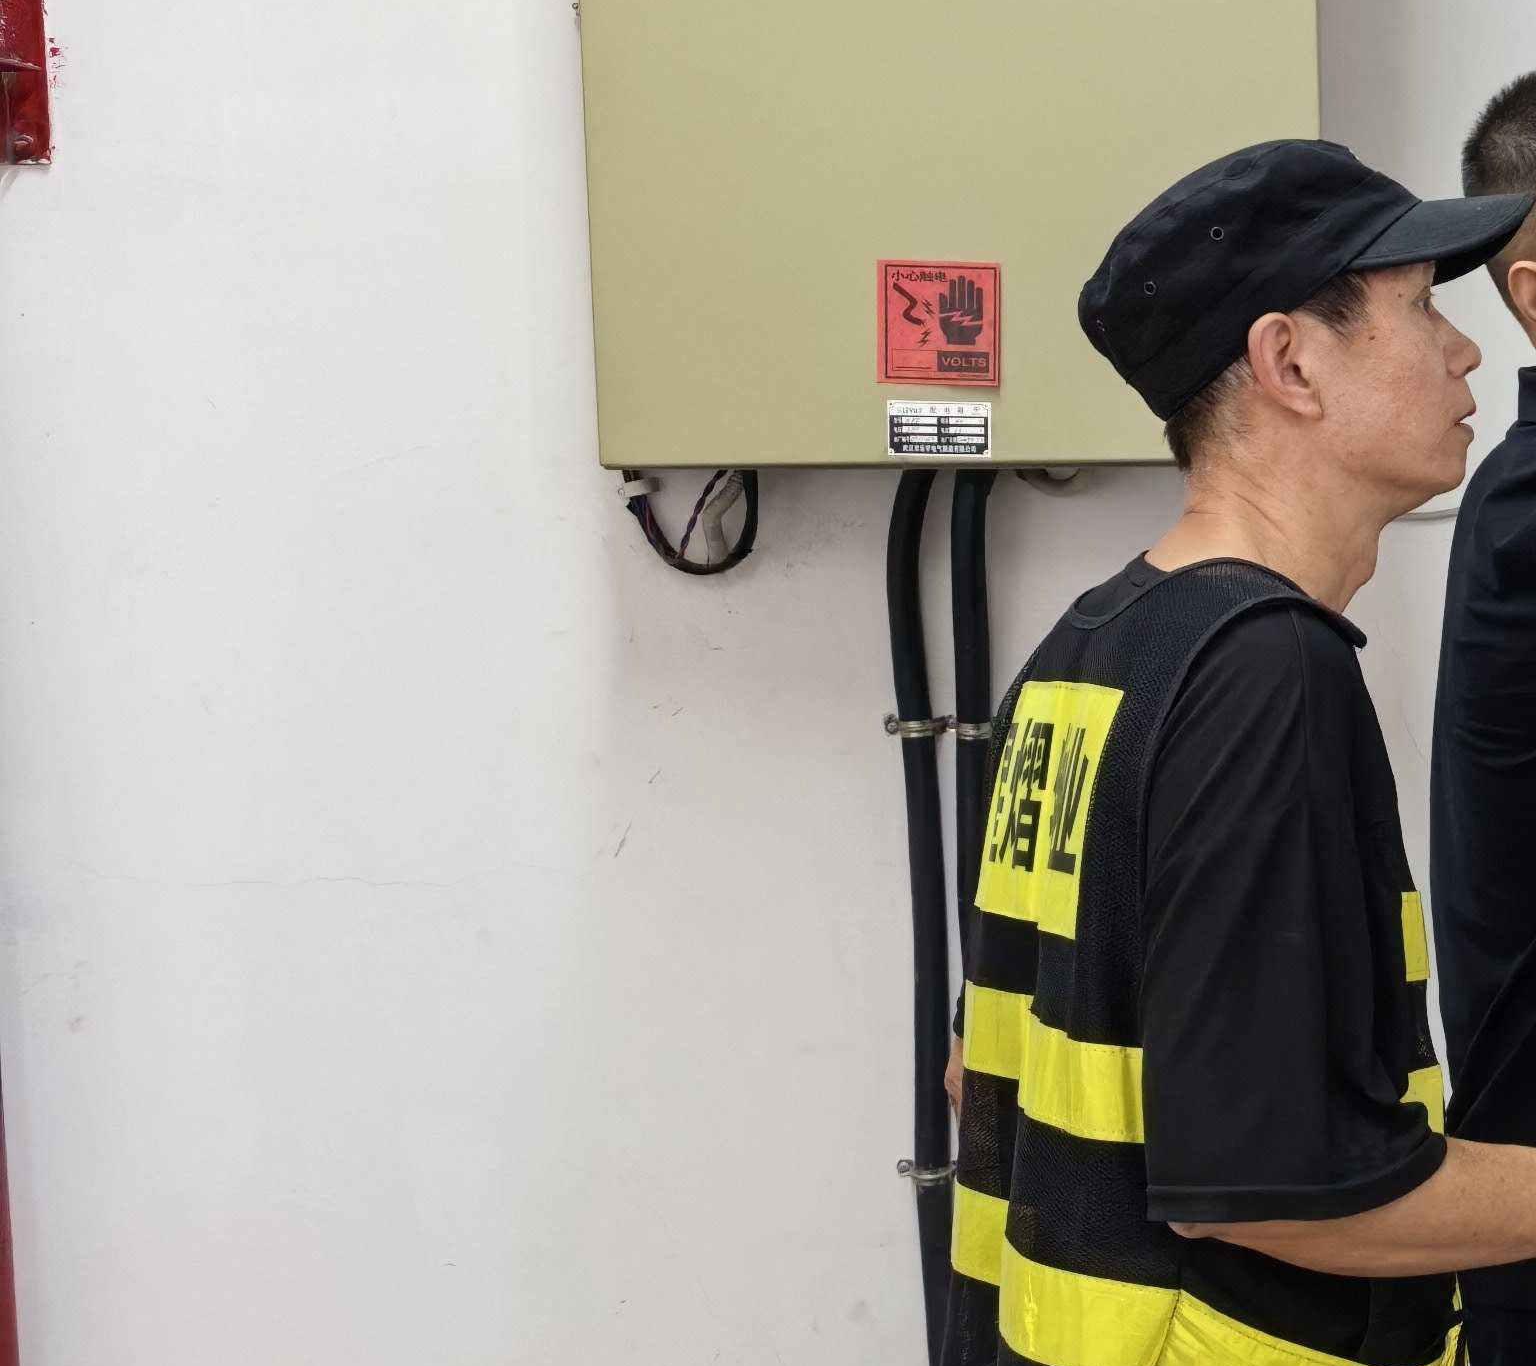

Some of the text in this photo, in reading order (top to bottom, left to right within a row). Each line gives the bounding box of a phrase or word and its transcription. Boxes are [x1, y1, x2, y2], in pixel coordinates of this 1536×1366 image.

[891, 268, 948, 283] 小心触电
[941, 356, 987, 367] VOLTS
